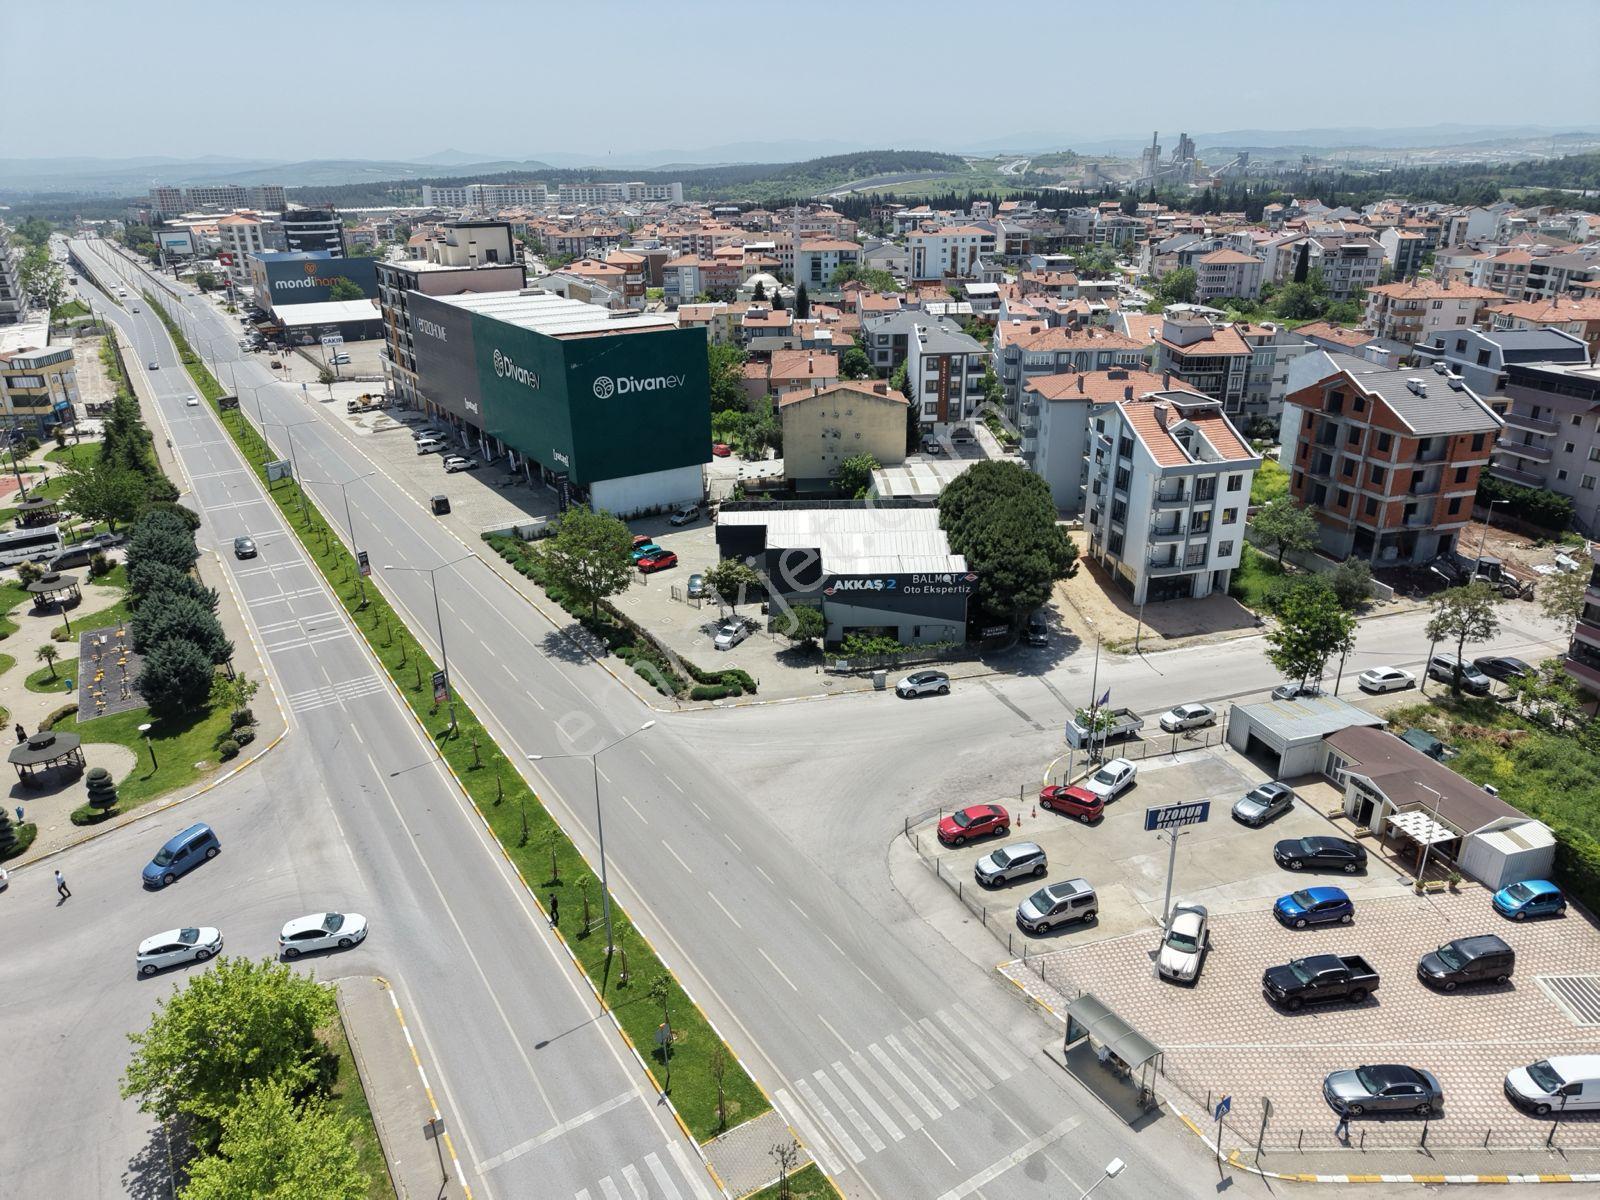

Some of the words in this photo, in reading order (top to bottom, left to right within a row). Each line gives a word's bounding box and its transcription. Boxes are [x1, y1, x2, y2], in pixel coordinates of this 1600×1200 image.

[275, 276, 343, 290] mondihom
[503, 355, 540, 390] Divanev
[616, 374, 686, 394] Divanev
[833, 579, 884, 591] AKKAŞ
[886, 579, 897, 590] 2
[903, 586, 921, 594] Oto
[924, 584, 972, 595] Ekspertiz
